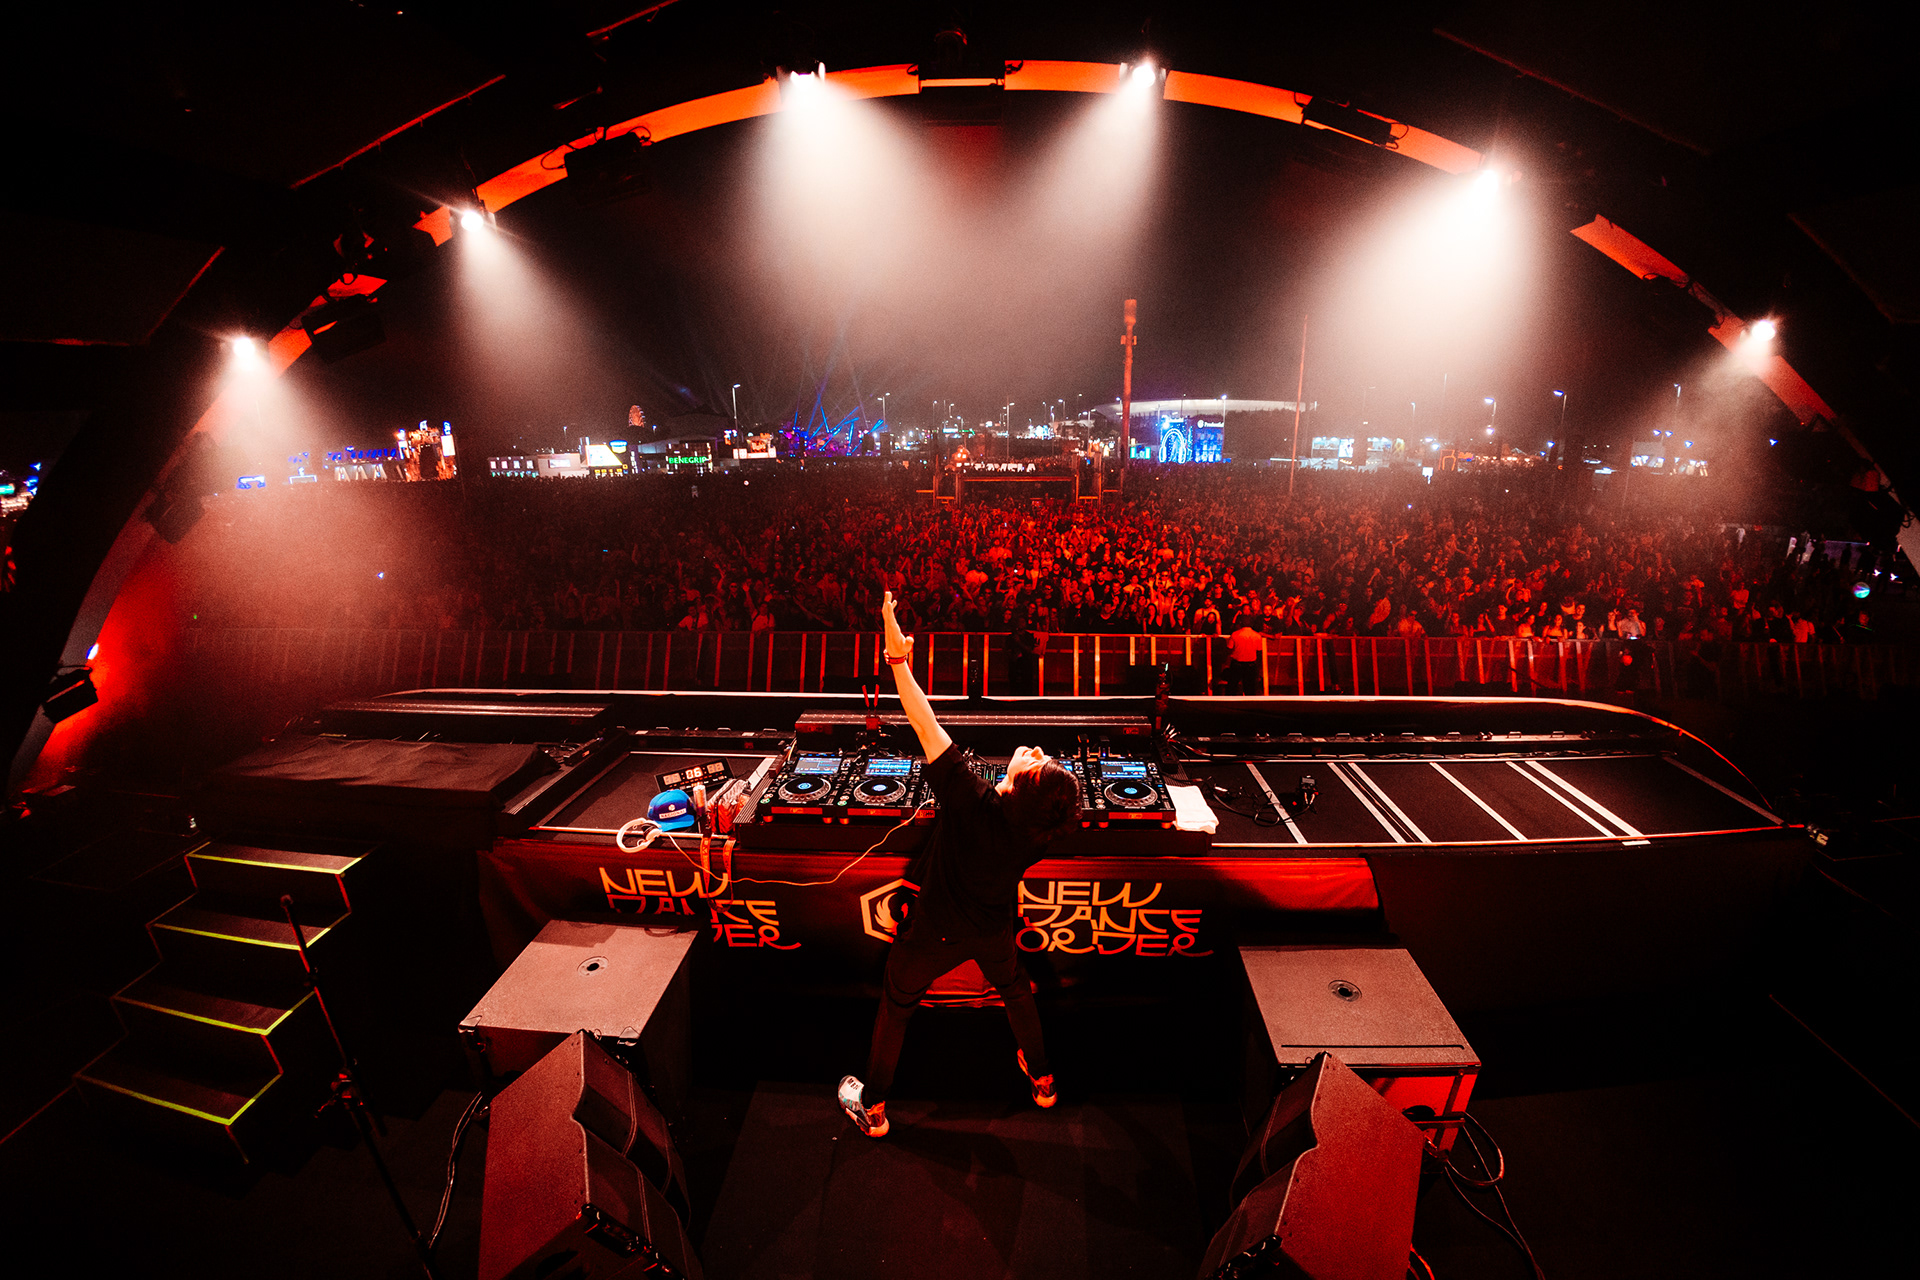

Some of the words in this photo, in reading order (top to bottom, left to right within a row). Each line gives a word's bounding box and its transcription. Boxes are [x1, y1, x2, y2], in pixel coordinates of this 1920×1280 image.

[668, 456, 707, 464] BENEGRIP
[598, 867, 729, 899] NEW
[1018, 880, 1163, 908] NEW
[1018, 903, 1203, 934] DANCE
[1016, 926, 1215, 958] ORDER
